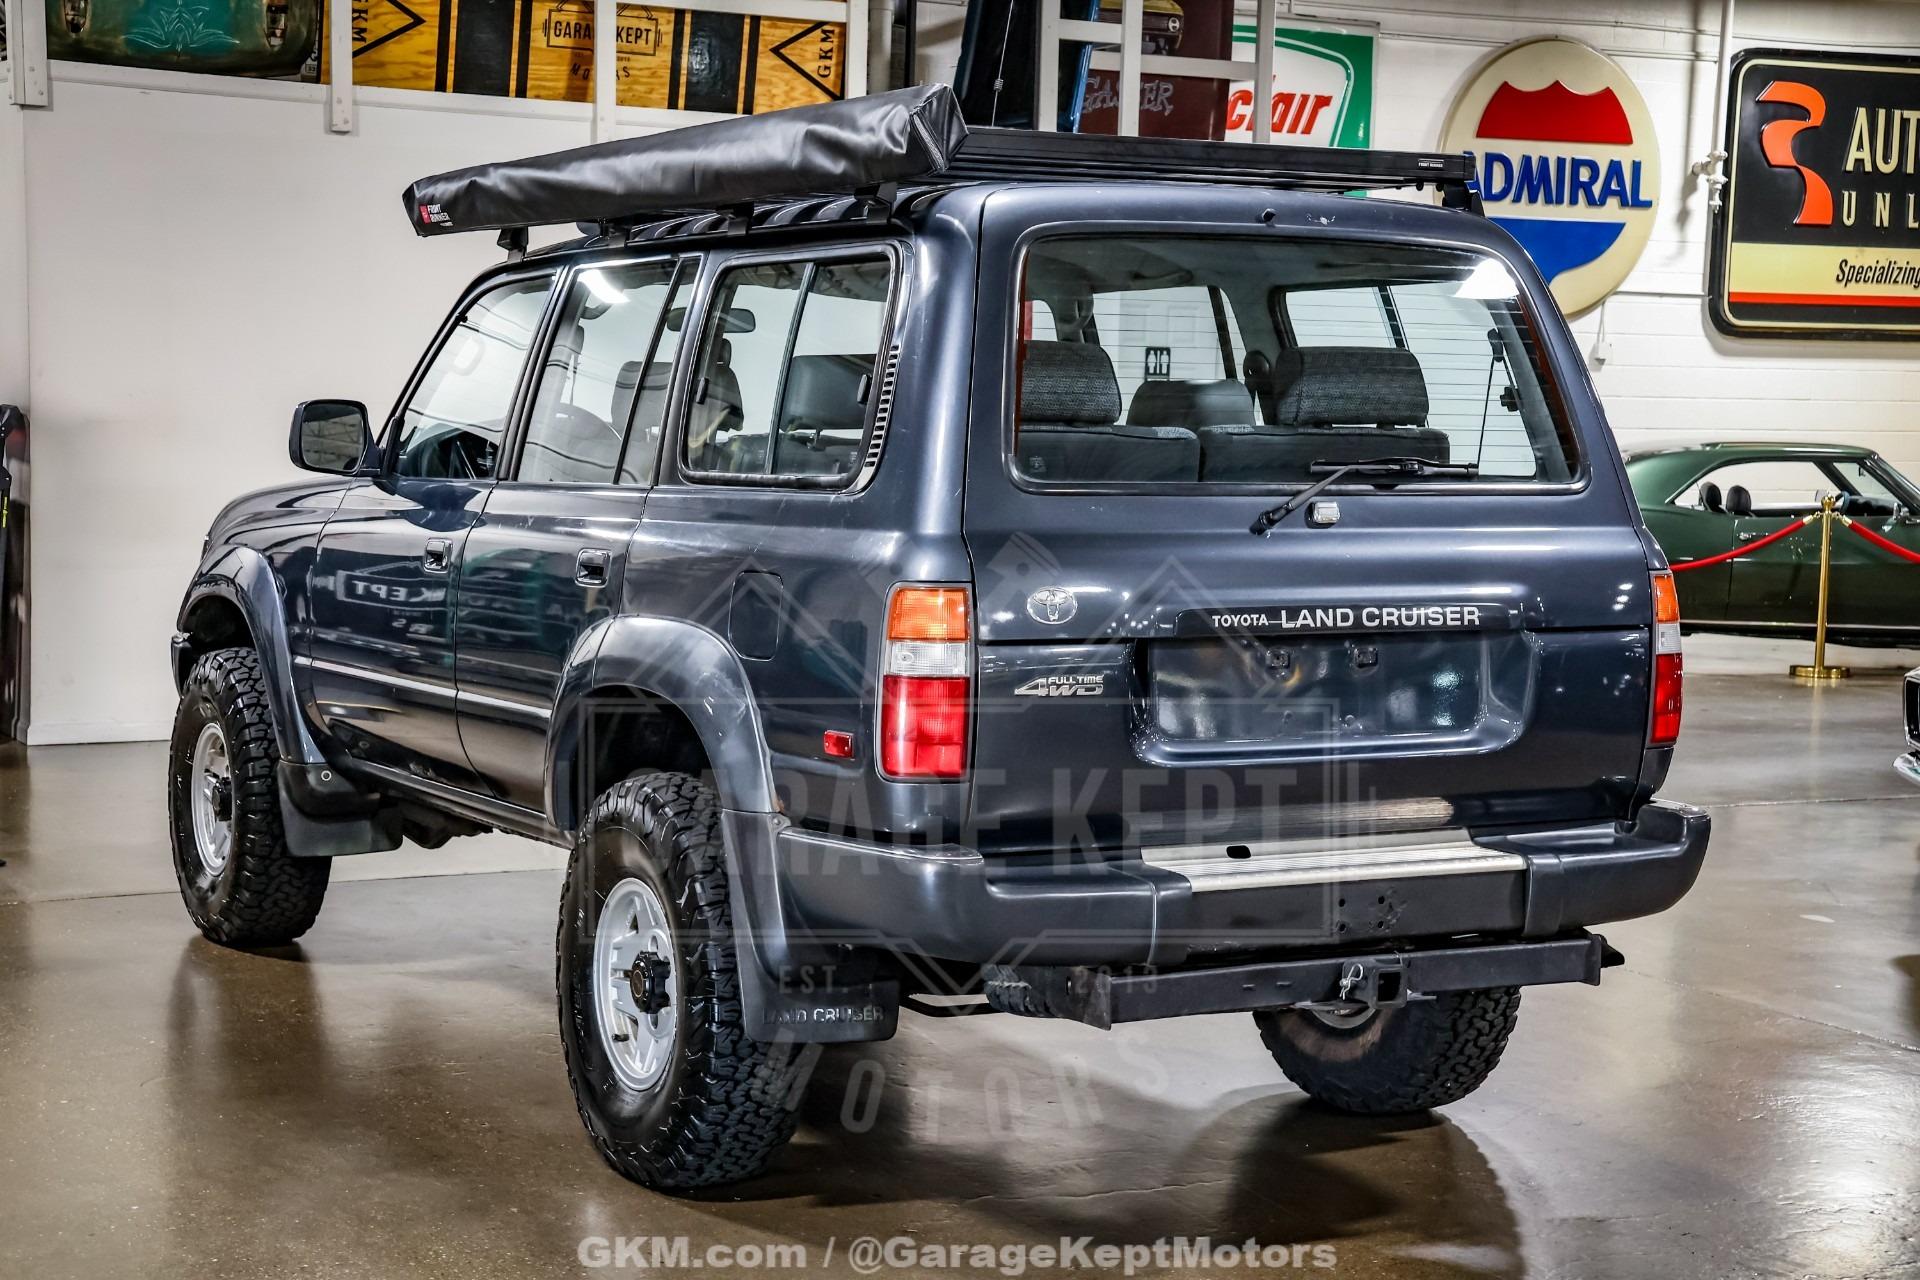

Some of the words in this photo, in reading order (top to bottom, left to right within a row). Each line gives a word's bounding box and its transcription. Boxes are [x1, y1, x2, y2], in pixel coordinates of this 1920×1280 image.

[352, 0, 368, 43] KM
[553, 20, 592, 40] GARA
[616, 25, 652, 45] KEPT
[817, 29, 835, 78] GKM
[1084, 76, 1174, 116] GAER
[1226, 89, 1333, 135] cair
[1836, 258, 1920, 289] Specializing
[1212, 614, 1269, 628] TOYOTA
[1281, 607, 1354, 629] LAND
[1362, 606, 1480, 628] CRUISER
[1014, 677, 1104, 697] 4WD
[1048, 675, 1076, 685] FULL
[1077, 674, 1104, 684] TIME
[763, 1007, 807, 1025] LAND
[813, 1004, 885, 1023] CRUISER
